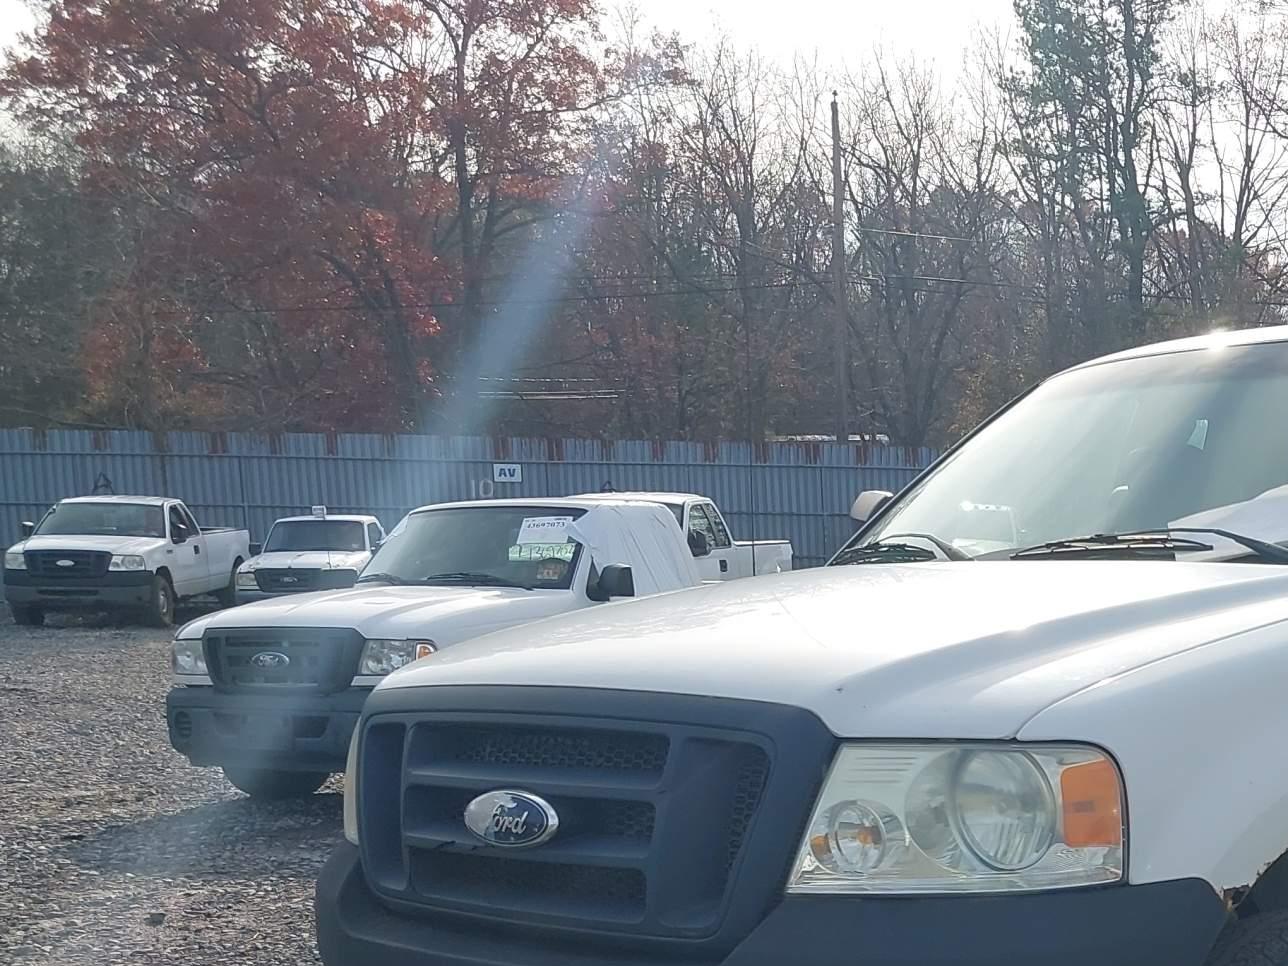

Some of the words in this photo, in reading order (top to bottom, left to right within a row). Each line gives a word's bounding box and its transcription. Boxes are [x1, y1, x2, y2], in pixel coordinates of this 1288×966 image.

[498, 467, 516, 478] AV
[470, 479, 494, 498] 10
[484, 800, 529, 837] Ford
